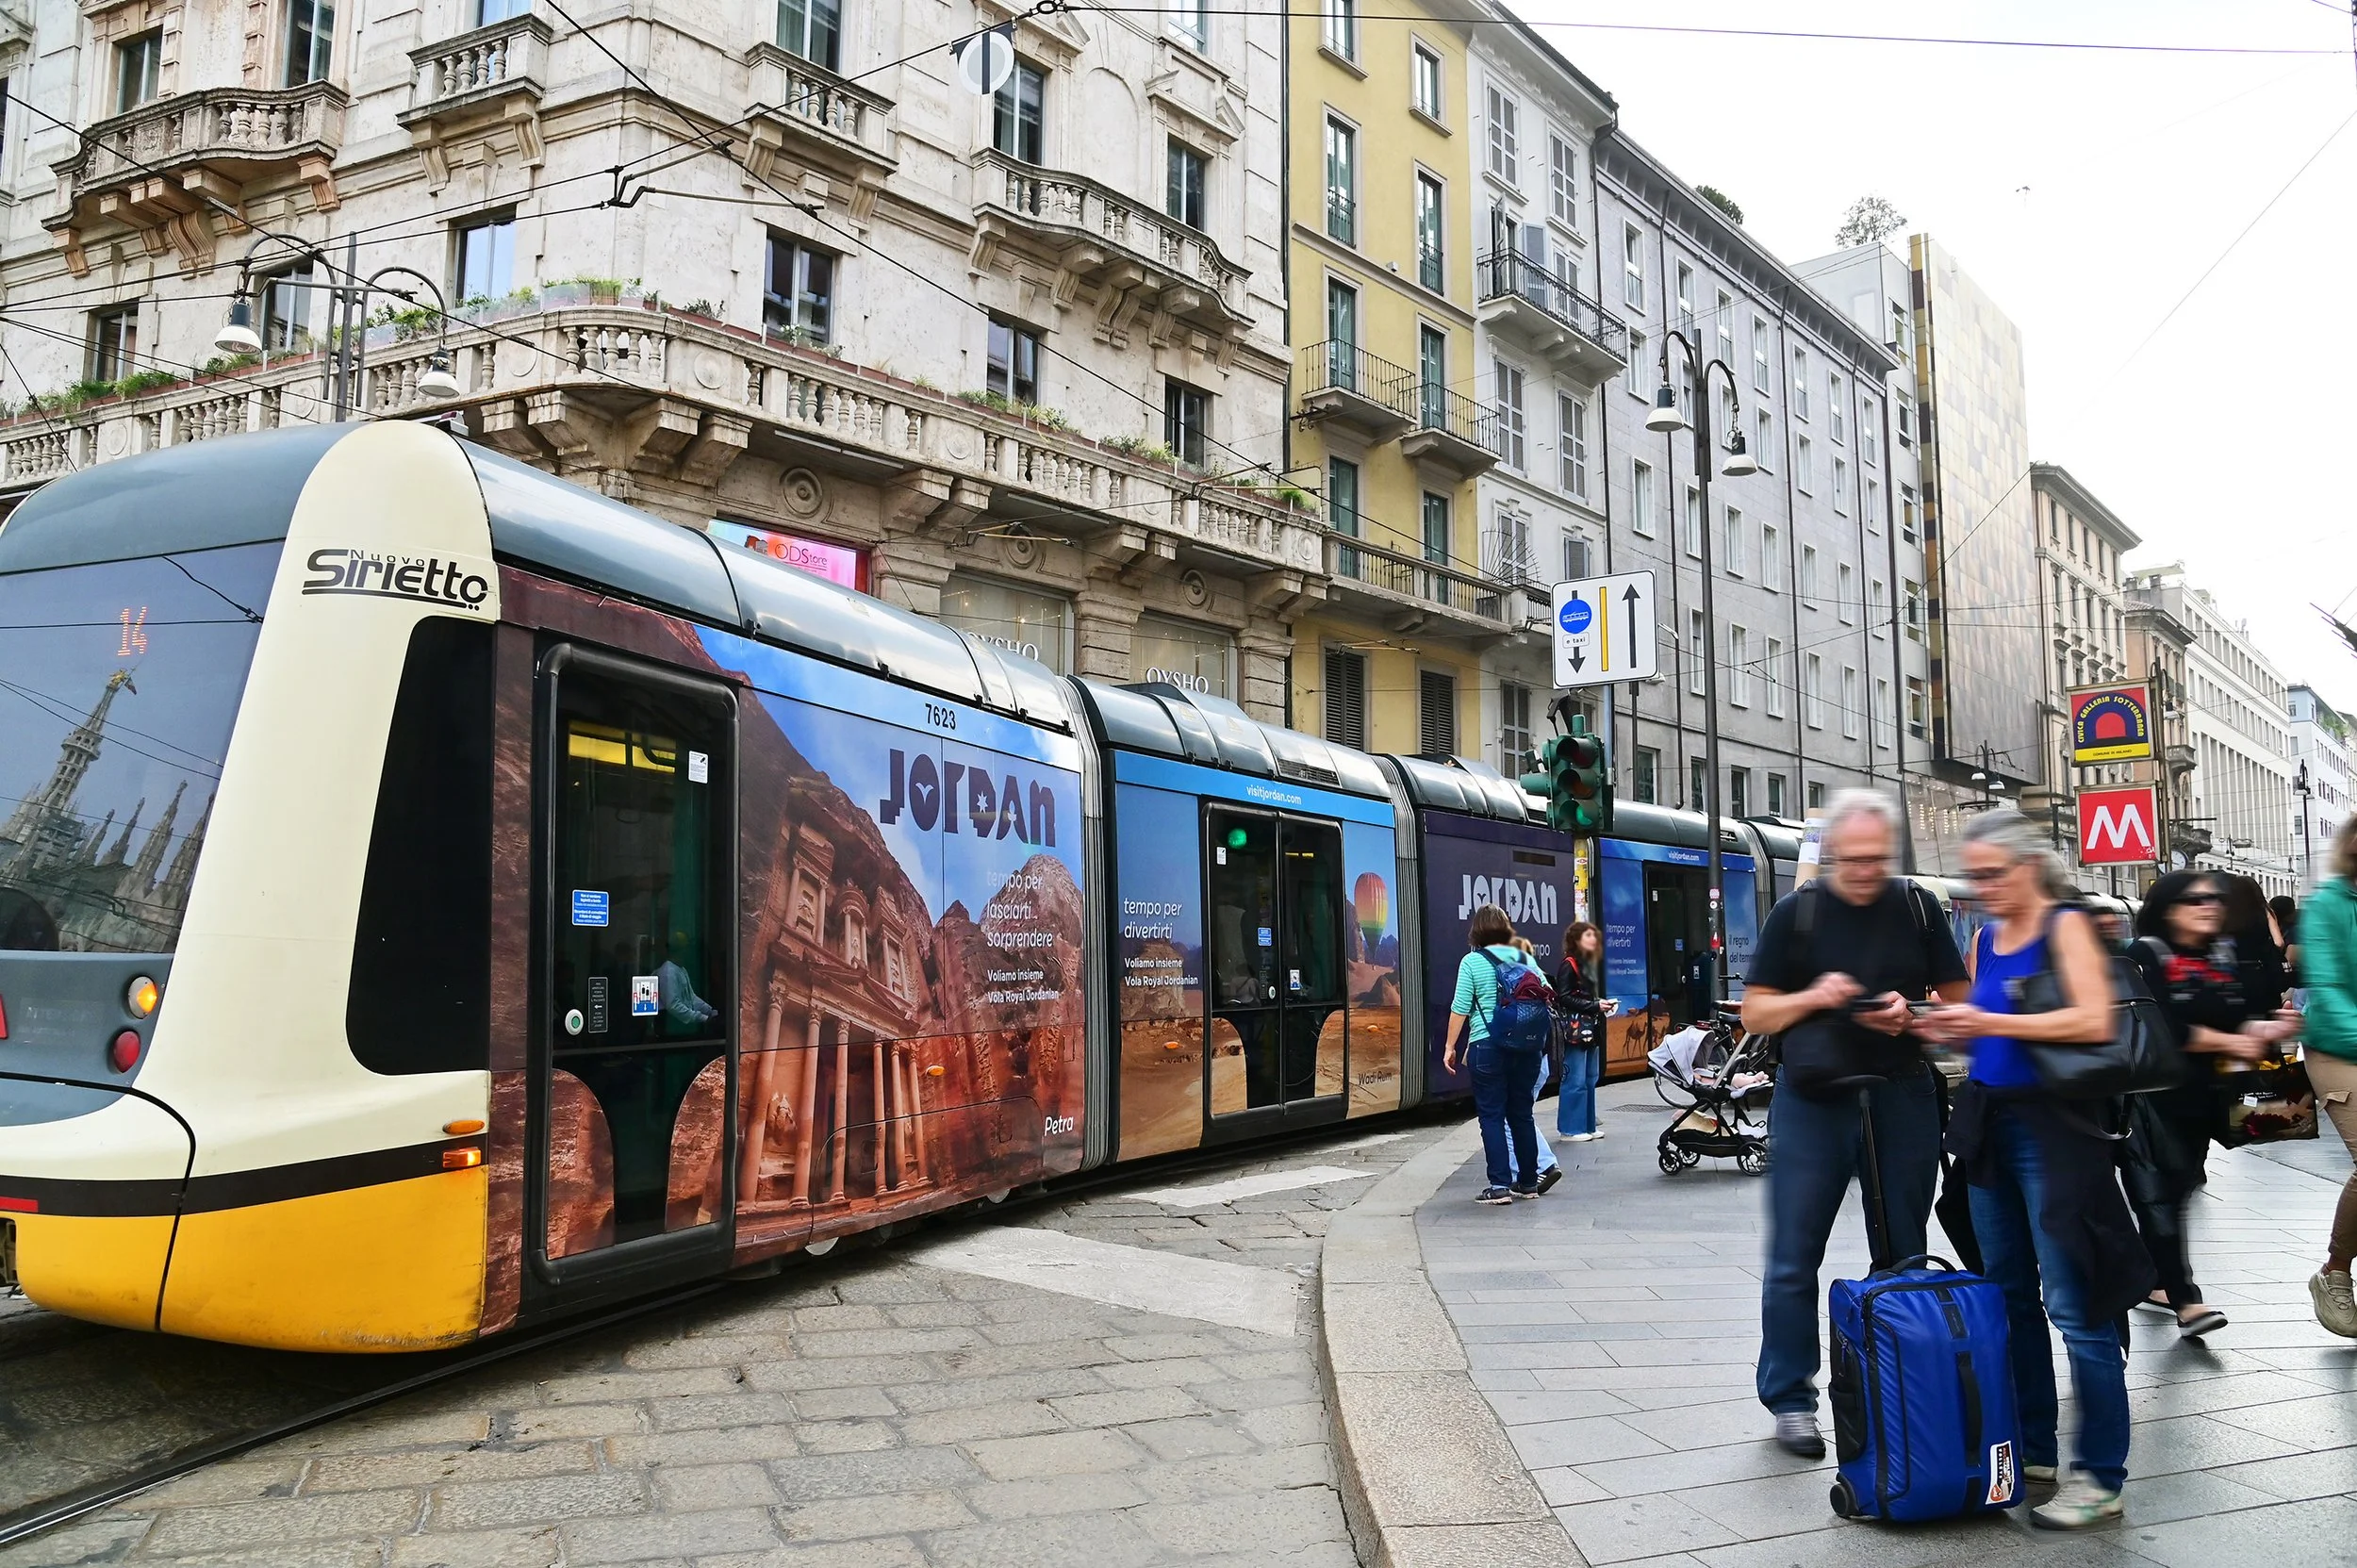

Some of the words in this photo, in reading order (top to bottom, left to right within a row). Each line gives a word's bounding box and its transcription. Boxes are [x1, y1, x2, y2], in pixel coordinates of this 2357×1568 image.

[350, 549, 425, 567] Nuovo
[303, 548, 488, 604] Sirietto
[117, 606, 147, 656] 14
[1146, 666, 1210, 694] OYSHO
[925, 703, 956, 731] 7623
[2080, 696, 2110, 718] GALLERIA
[880, 748, 1056, 848] JORDAN
[1245, 784, 1302, 804] visitjordan.com
[2085, 803, 2151, 850] M
[987, 871, 1023, 893] tempo
[1024, 873, 1044, 893] per
[986, 899, 1032, 920] lasciarti
[1124, 898, 1162, 918] tempo
[1162, 902, 1182, 919] per
[1459, 874, 1558, 925] JORDAN
[986, 928, 1053, 951] sorprendere
[1124, 921, 1173, 939] divertirti
[1625, 925, 1636, 935] per
[1733, 936, 1750, 949] regno
[1124, 957, 1155, 968] Voliamo
[1155, 957, 1182, 968] insieme
[1729, 952, 1739, 964] del
[987, 968, 1016, 982] Voliamo
[1017, 967, 1044, 982] insieme
[1125, 975, 1142, 987] Vola
[1143, 975, 1163, 988] Royal
[1164, 974, 1198, 985] Jordanian
[988, 990, 1005, 1004] Vola
[1005, 988, 1026, 1004] Royal
[1026, 987, 1060, 1001] Jordanian
[1044, 1114, 1074, 1137] Petra
